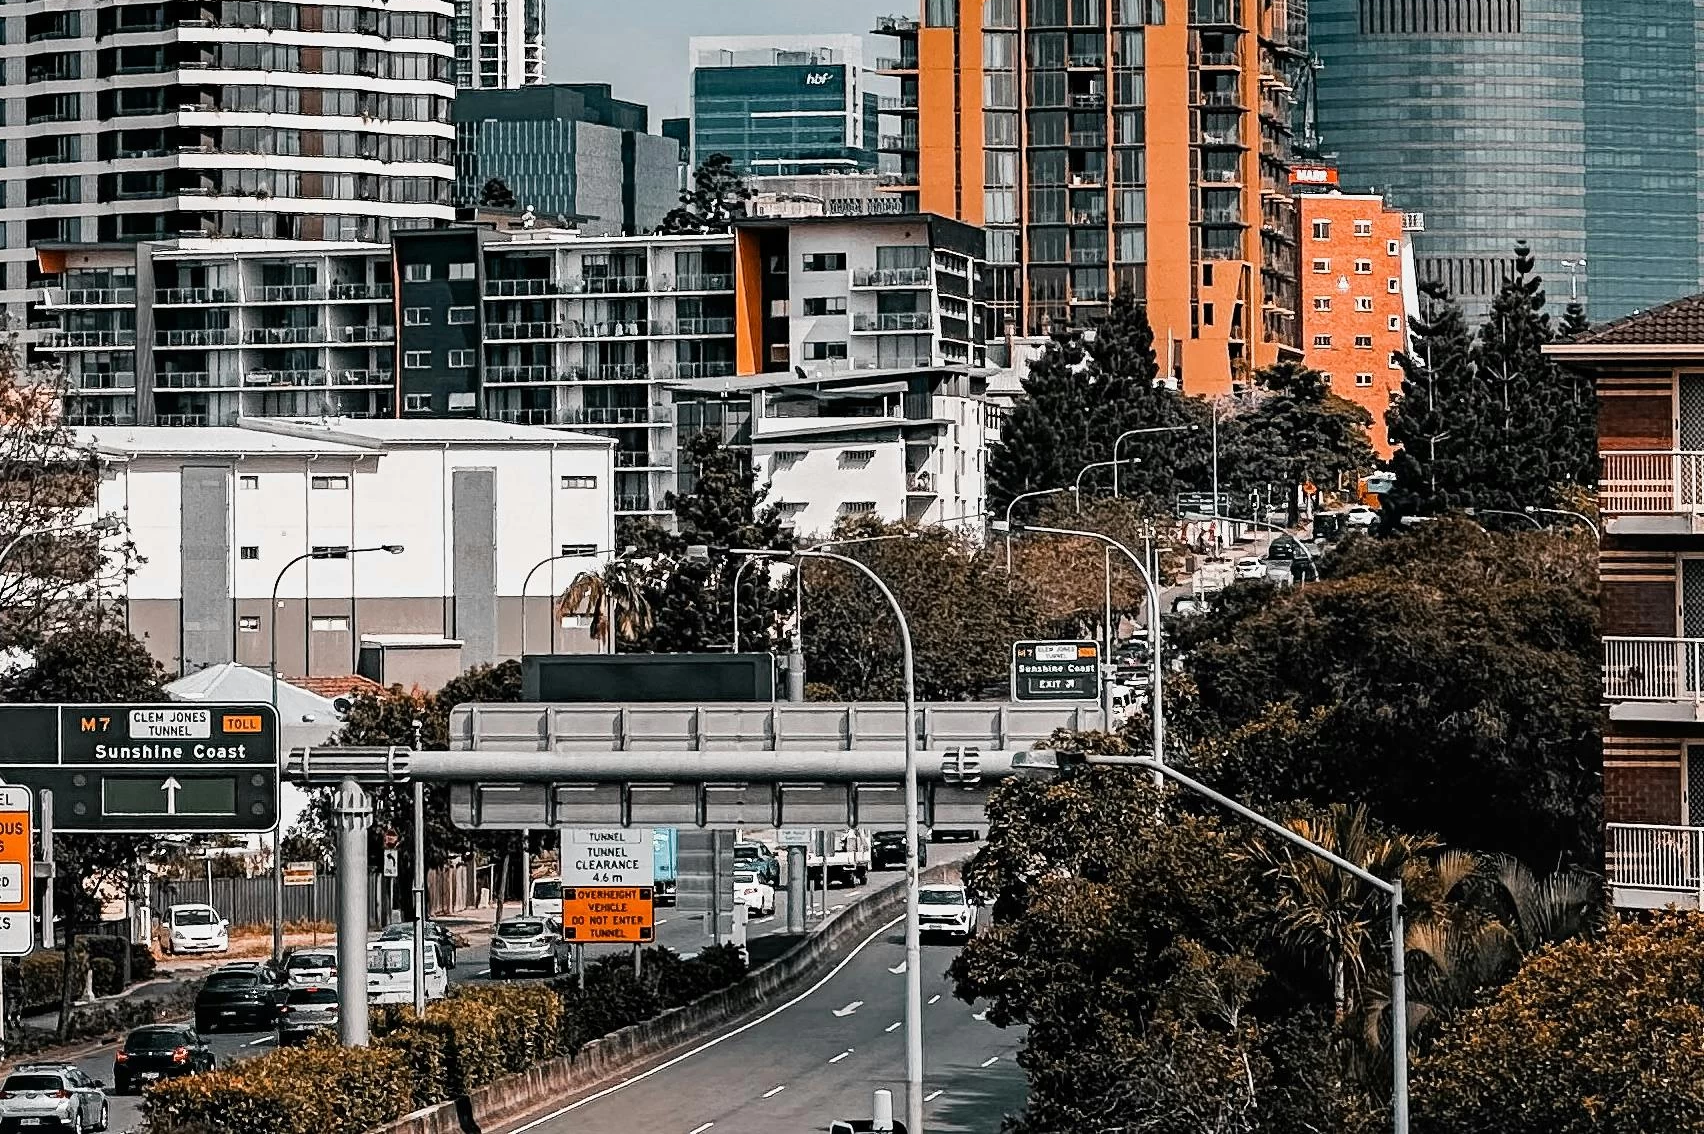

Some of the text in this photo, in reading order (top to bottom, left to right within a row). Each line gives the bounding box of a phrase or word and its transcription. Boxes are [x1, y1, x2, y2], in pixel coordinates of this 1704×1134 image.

[806, 72, 834, 85] hbf
[1018, 664, 1095, 673] Sunshine Coast
[1039, 679, 1061, 689] EXIT
[133, 711, 207, 723] CLEM JONES
[227, 718, 257, 730] TOLL
[148, 725, 192, 737] TUNNEL
[95, 744, 247, 759] Sunshine Coast
[589, 832, 626, 842] TUNNEL
[587, 847, 628, 857] TUNNEL
[575, 860, 639, 870] CLEARANCE
[592, 873, 623, 883] 4.6 m
[577, 890, 637, 900] OVERHEIGHT
[588, 903, 628, 913] VEHICLE
[571, 916, 644, 926] DO NOT ENTER
[590, 928, 627, 938] TUNNEL
